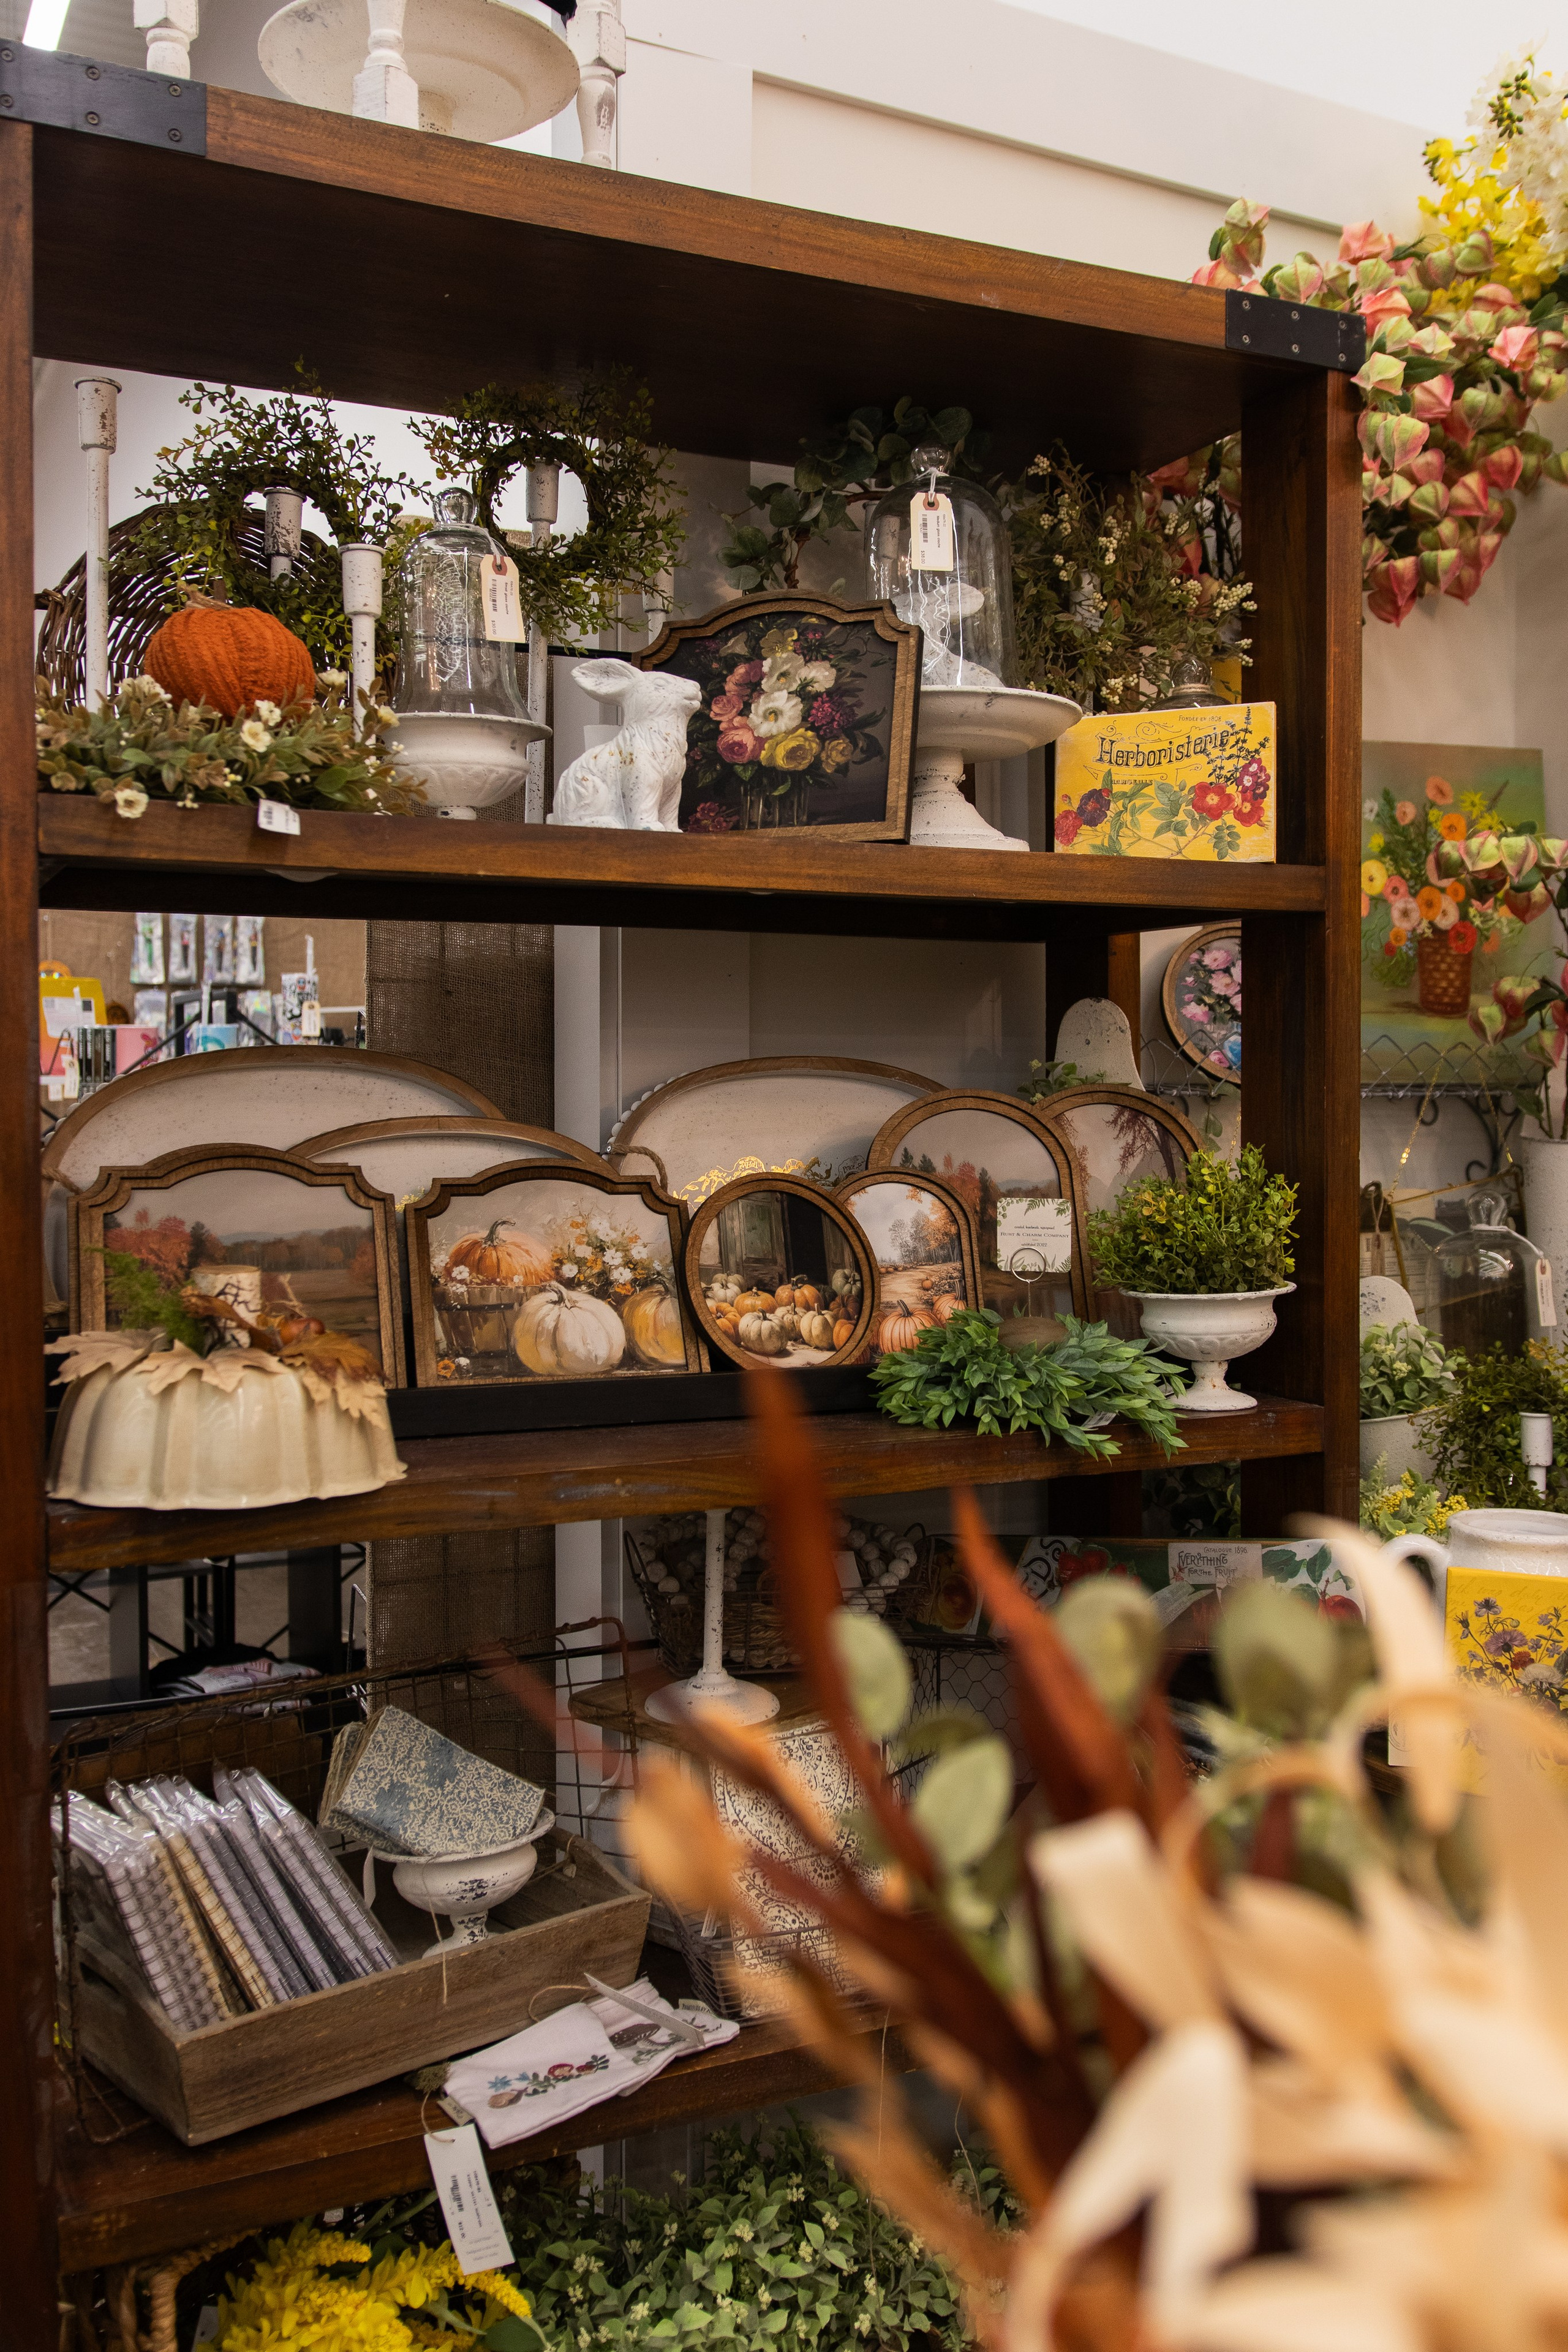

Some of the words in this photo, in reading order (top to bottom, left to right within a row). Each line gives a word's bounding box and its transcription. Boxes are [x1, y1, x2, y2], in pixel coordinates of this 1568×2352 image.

[1093, 726, 1231, 768] Herboristerie
[1178, 1551, 1228, 1567] EVERYTHING
[1188, 1567, 1200, 1577] FOR
[1214, 1566, 1237, 1578] FRUIT
